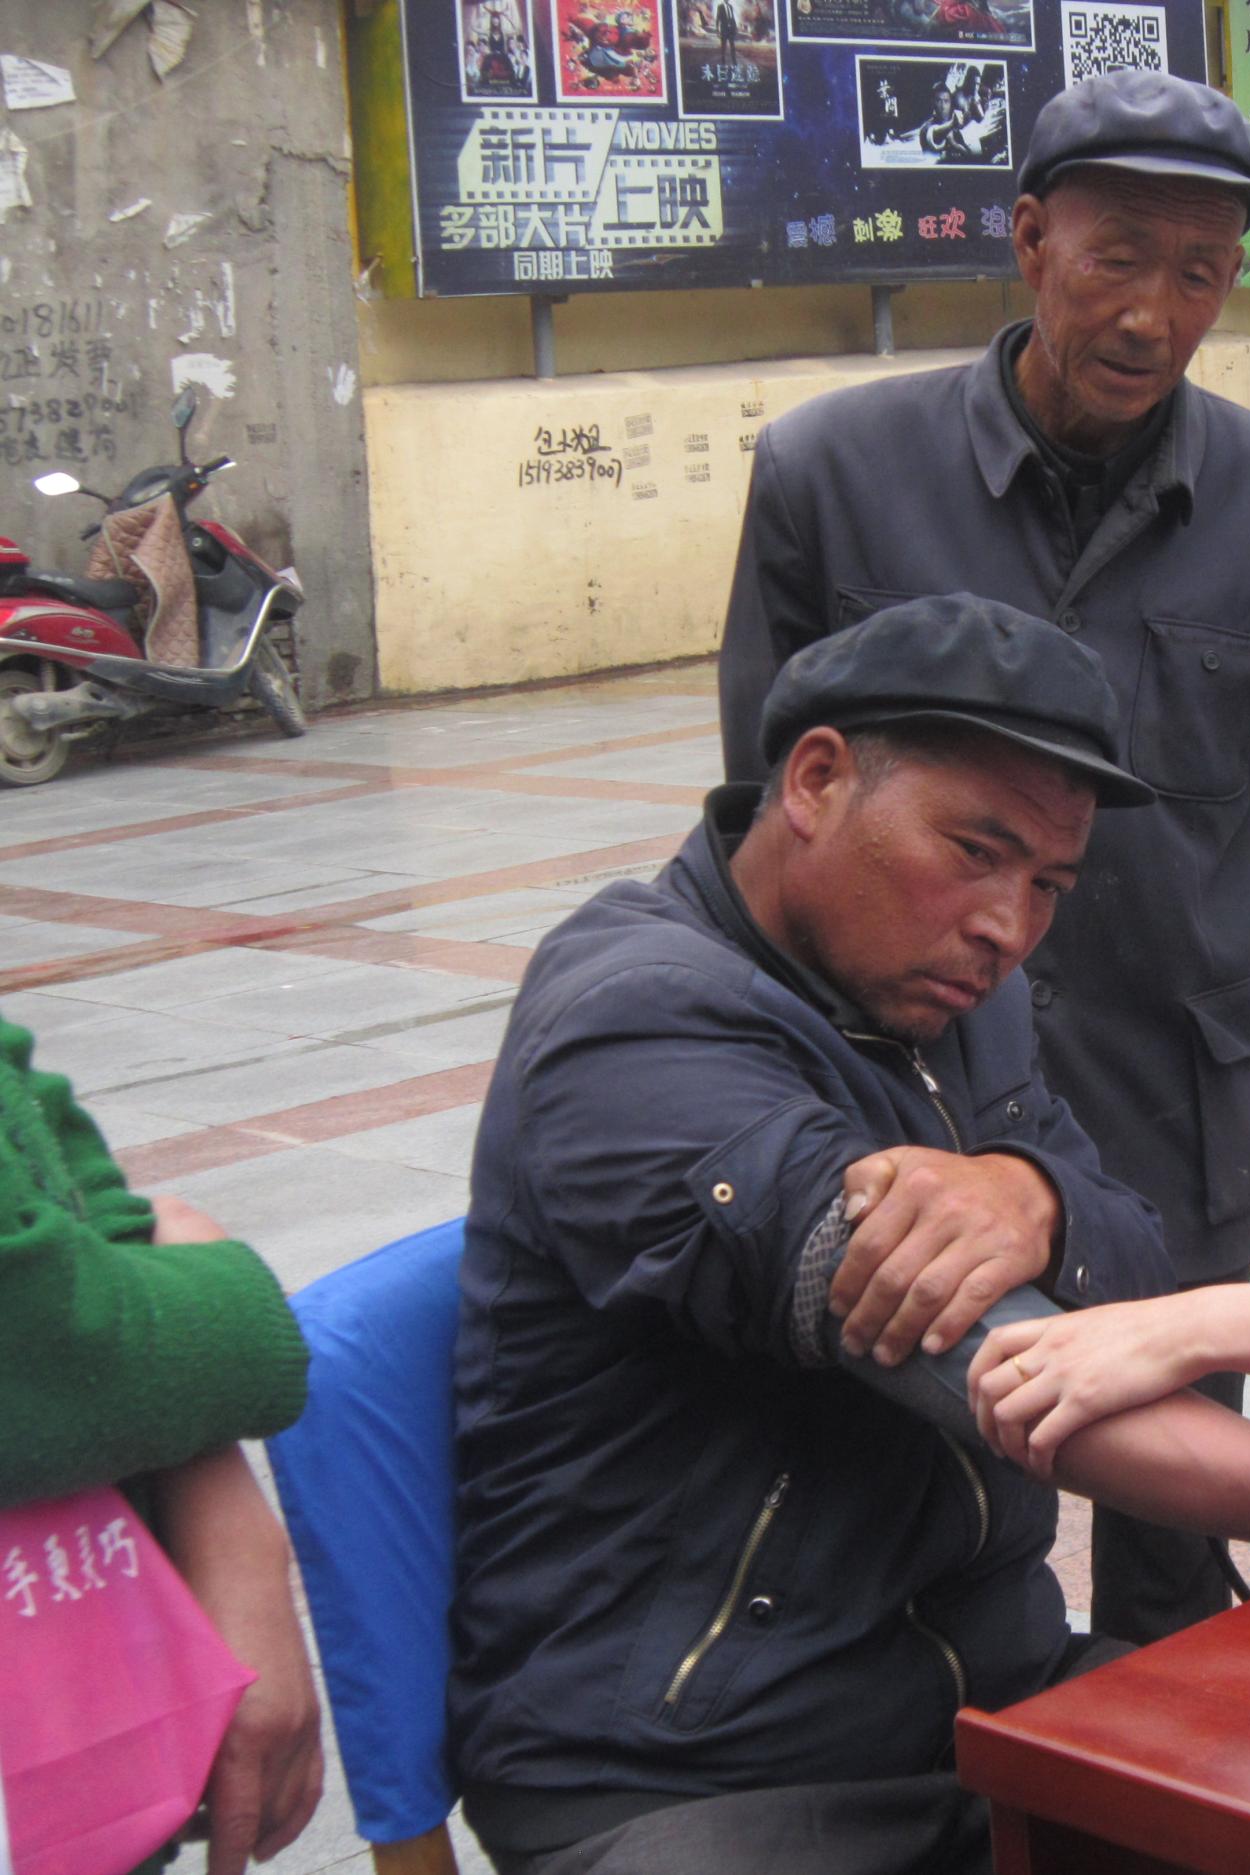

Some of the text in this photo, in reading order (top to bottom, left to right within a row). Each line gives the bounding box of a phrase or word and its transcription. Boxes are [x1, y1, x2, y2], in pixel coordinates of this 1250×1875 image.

[479, 126, 592, 185] 新片
[620, 121, 718, 150] MOVIES
[603, 173, 712, 231] 上映
[440, 204, 591, 250] 多部大片
[852, 207, 904, 243] 刺激
[980, 204, 1013, 239] 浪
[513, 249, 614, 281] 同期上映
